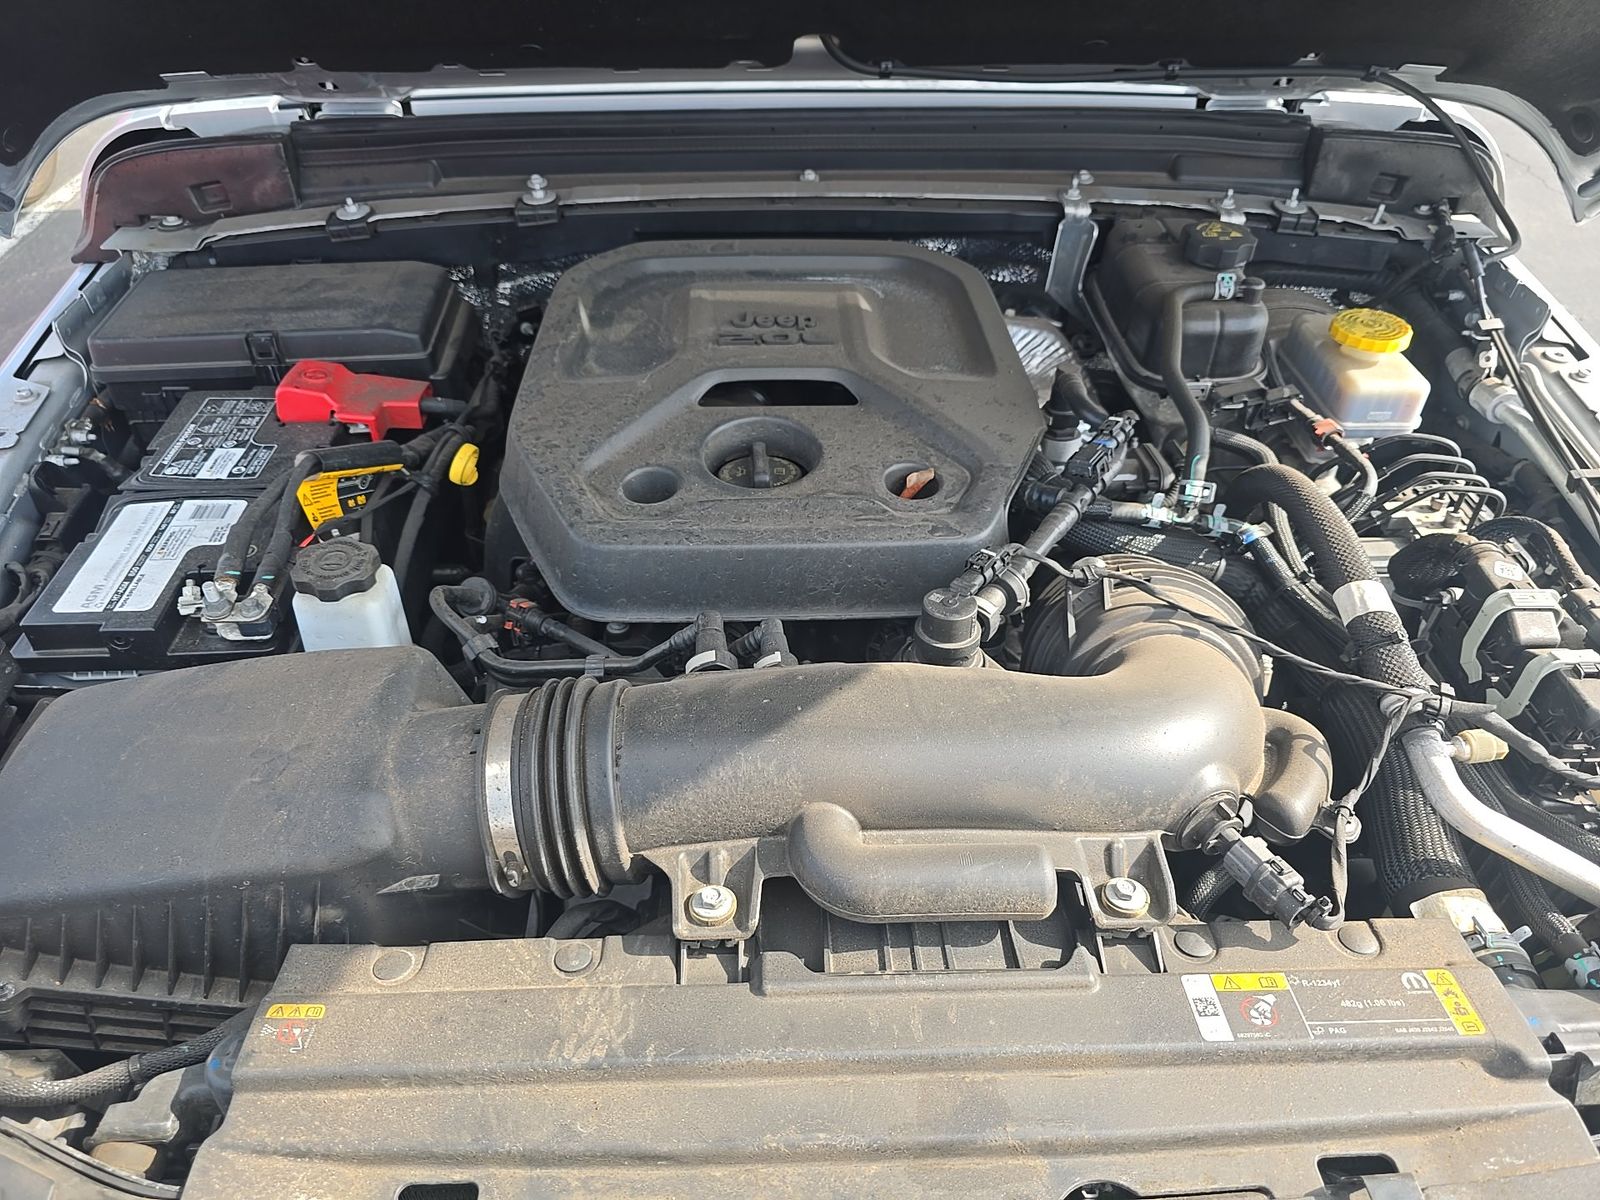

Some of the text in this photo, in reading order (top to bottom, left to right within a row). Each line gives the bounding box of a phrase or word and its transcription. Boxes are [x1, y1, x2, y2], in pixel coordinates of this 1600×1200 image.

[730, 311, 817, 331] Jeep
[717, 332, 834, 346] 2.0L
[79, 584, 105, 608] AGM
[1301, 979, 1341, 988] R-1234yf
[1340, 999, 1363, 1009] 482g
